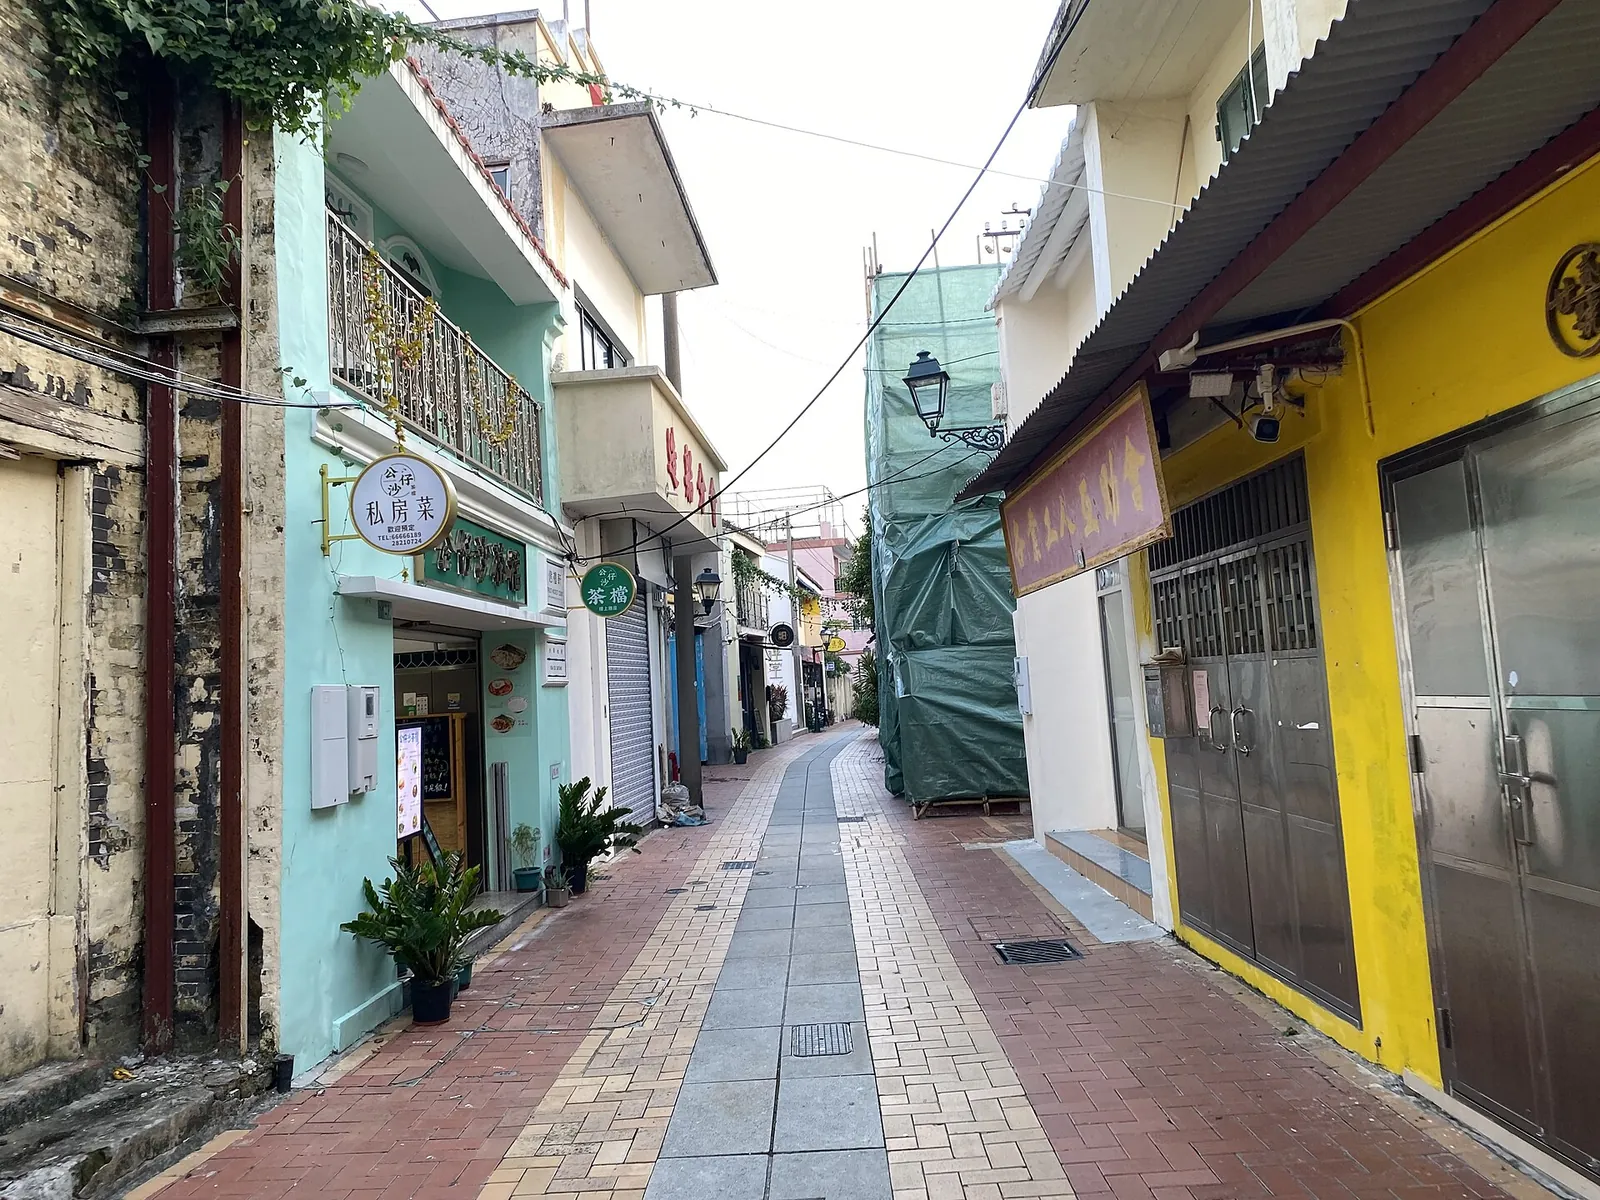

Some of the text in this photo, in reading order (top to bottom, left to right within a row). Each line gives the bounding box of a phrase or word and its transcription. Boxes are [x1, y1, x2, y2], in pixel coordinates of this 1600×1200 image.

[366, 496, 434, 526] 私房菜
[391, 538, 422, 546] 28210724
[587, 585, 629, 606] 茶檔
